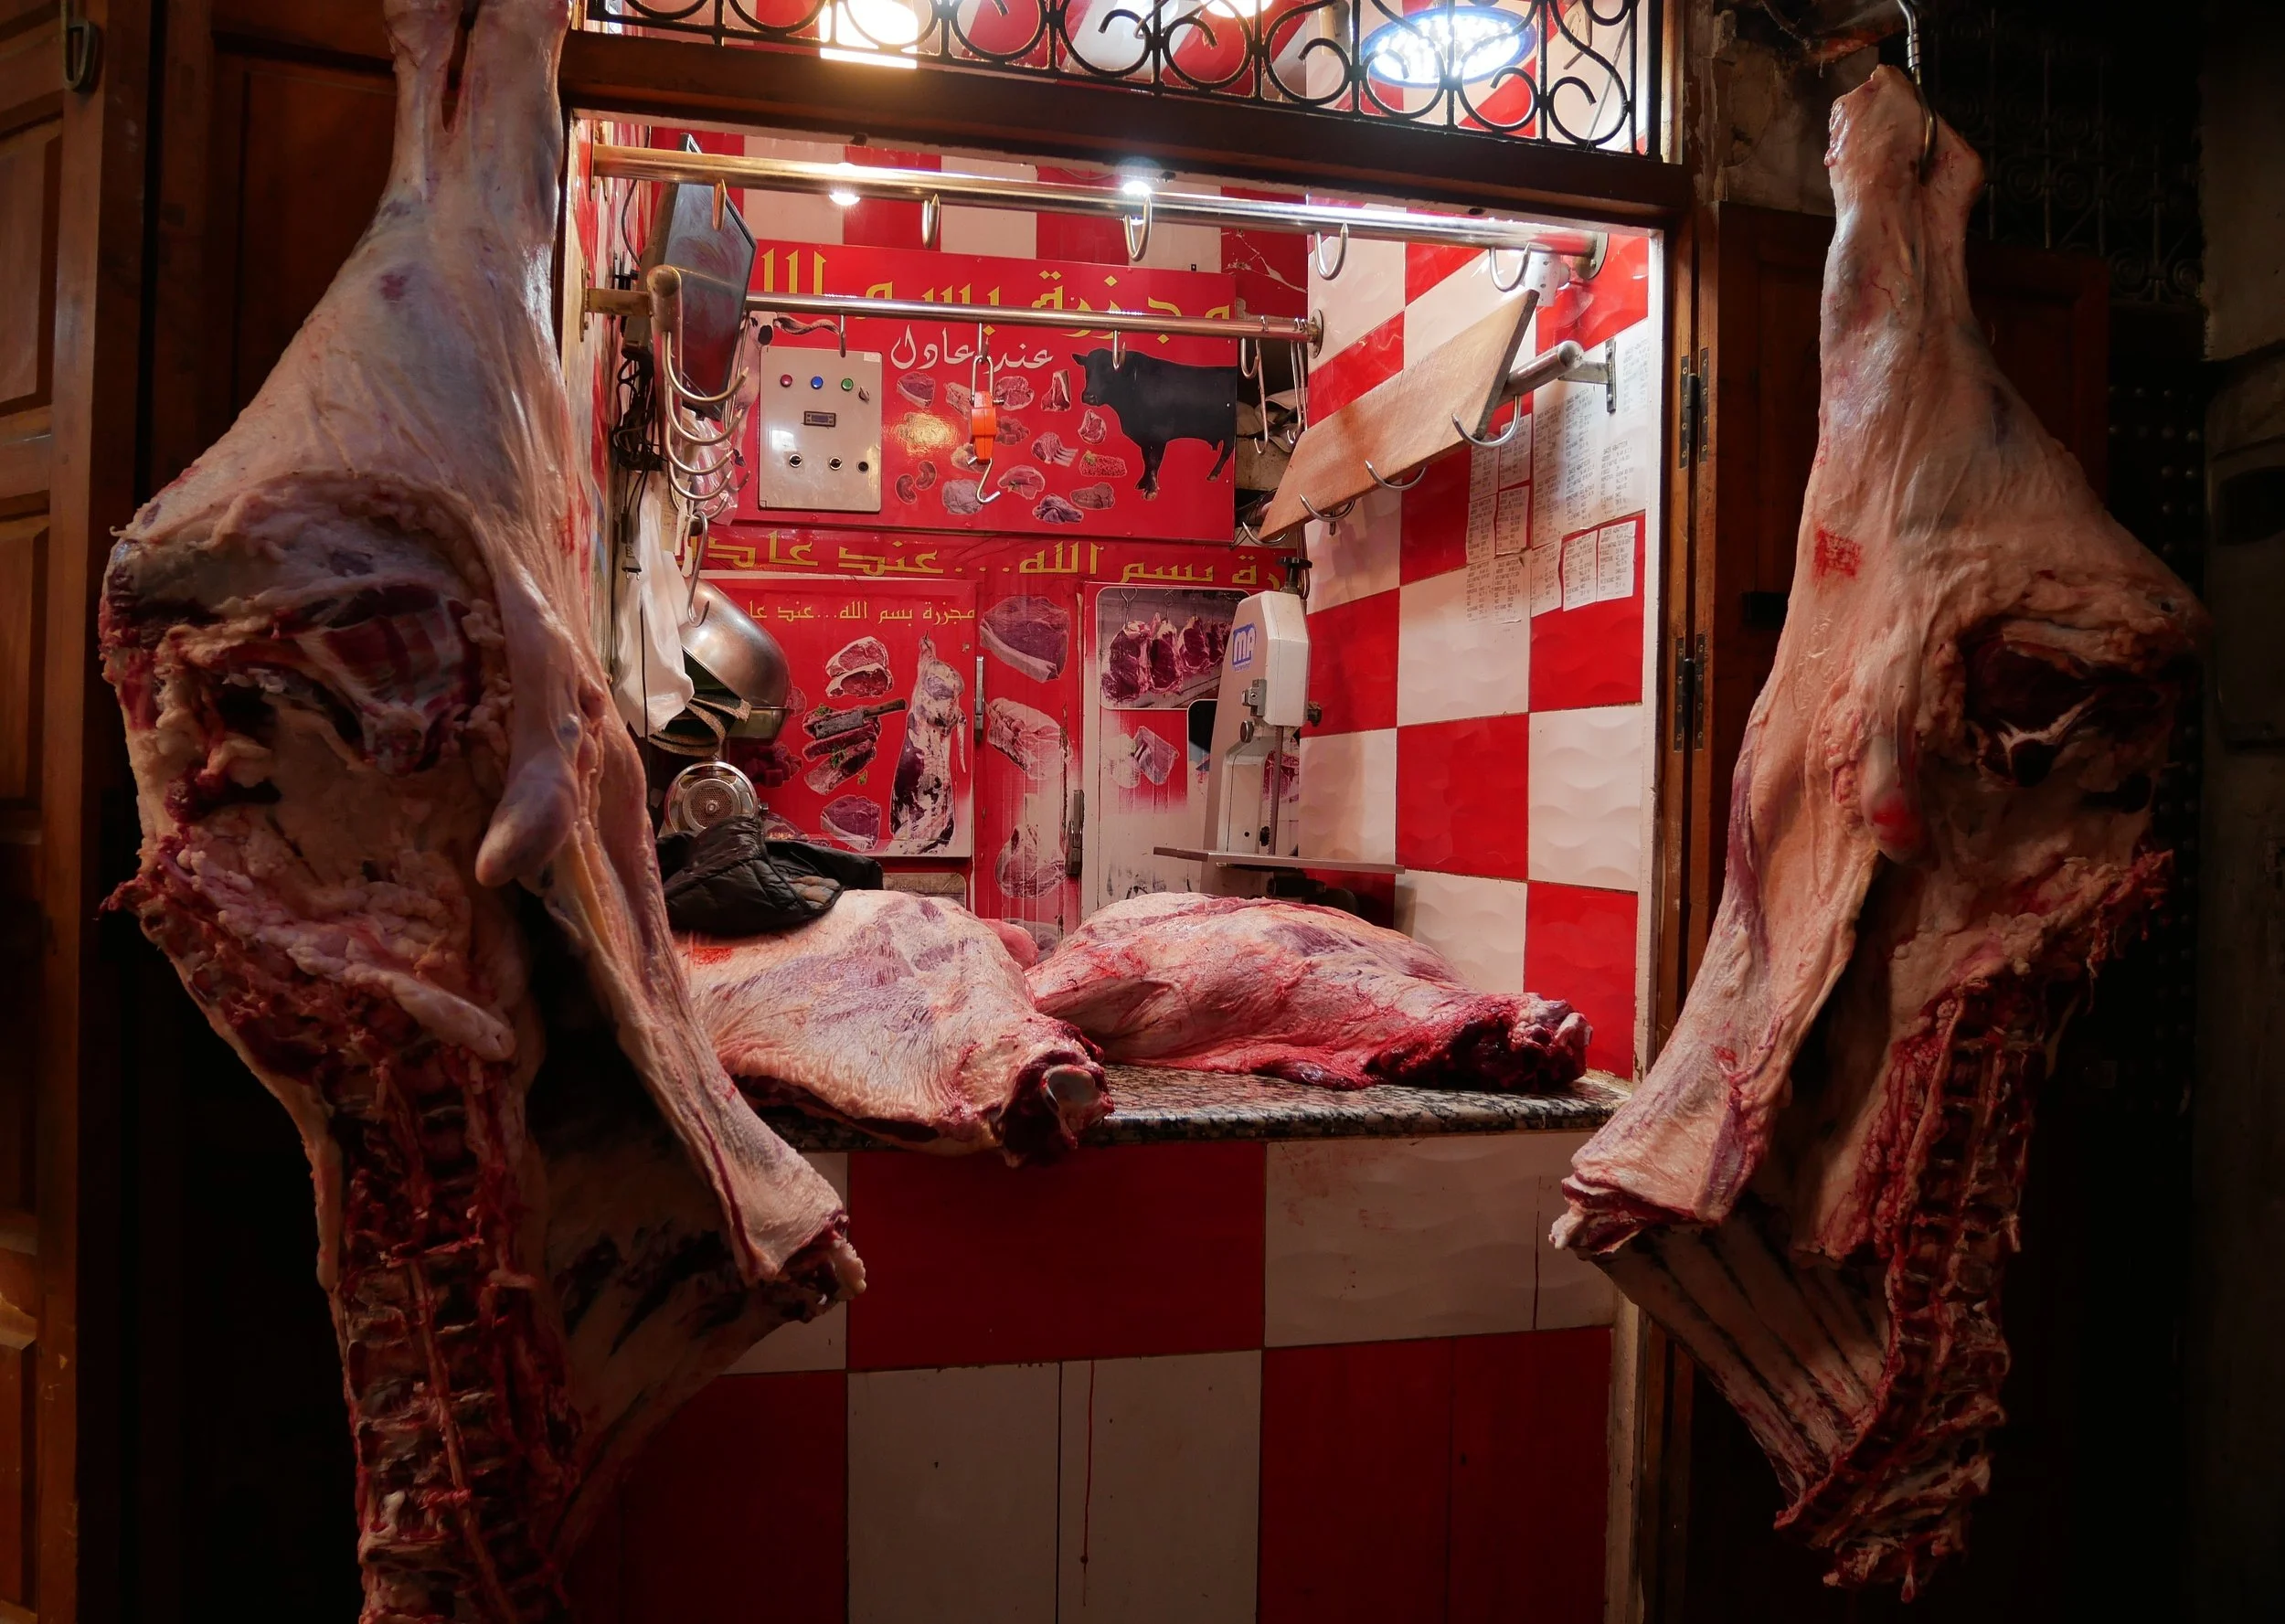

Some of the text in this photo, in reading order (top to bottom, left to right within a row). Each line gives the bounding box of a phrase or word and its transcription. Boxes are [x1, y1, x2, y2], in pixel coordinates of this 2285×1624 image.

[983, 343, 1054, 374] عند
[877, 608, 913, 627] بسم
[921, 600, 975, 625] مجزرة
